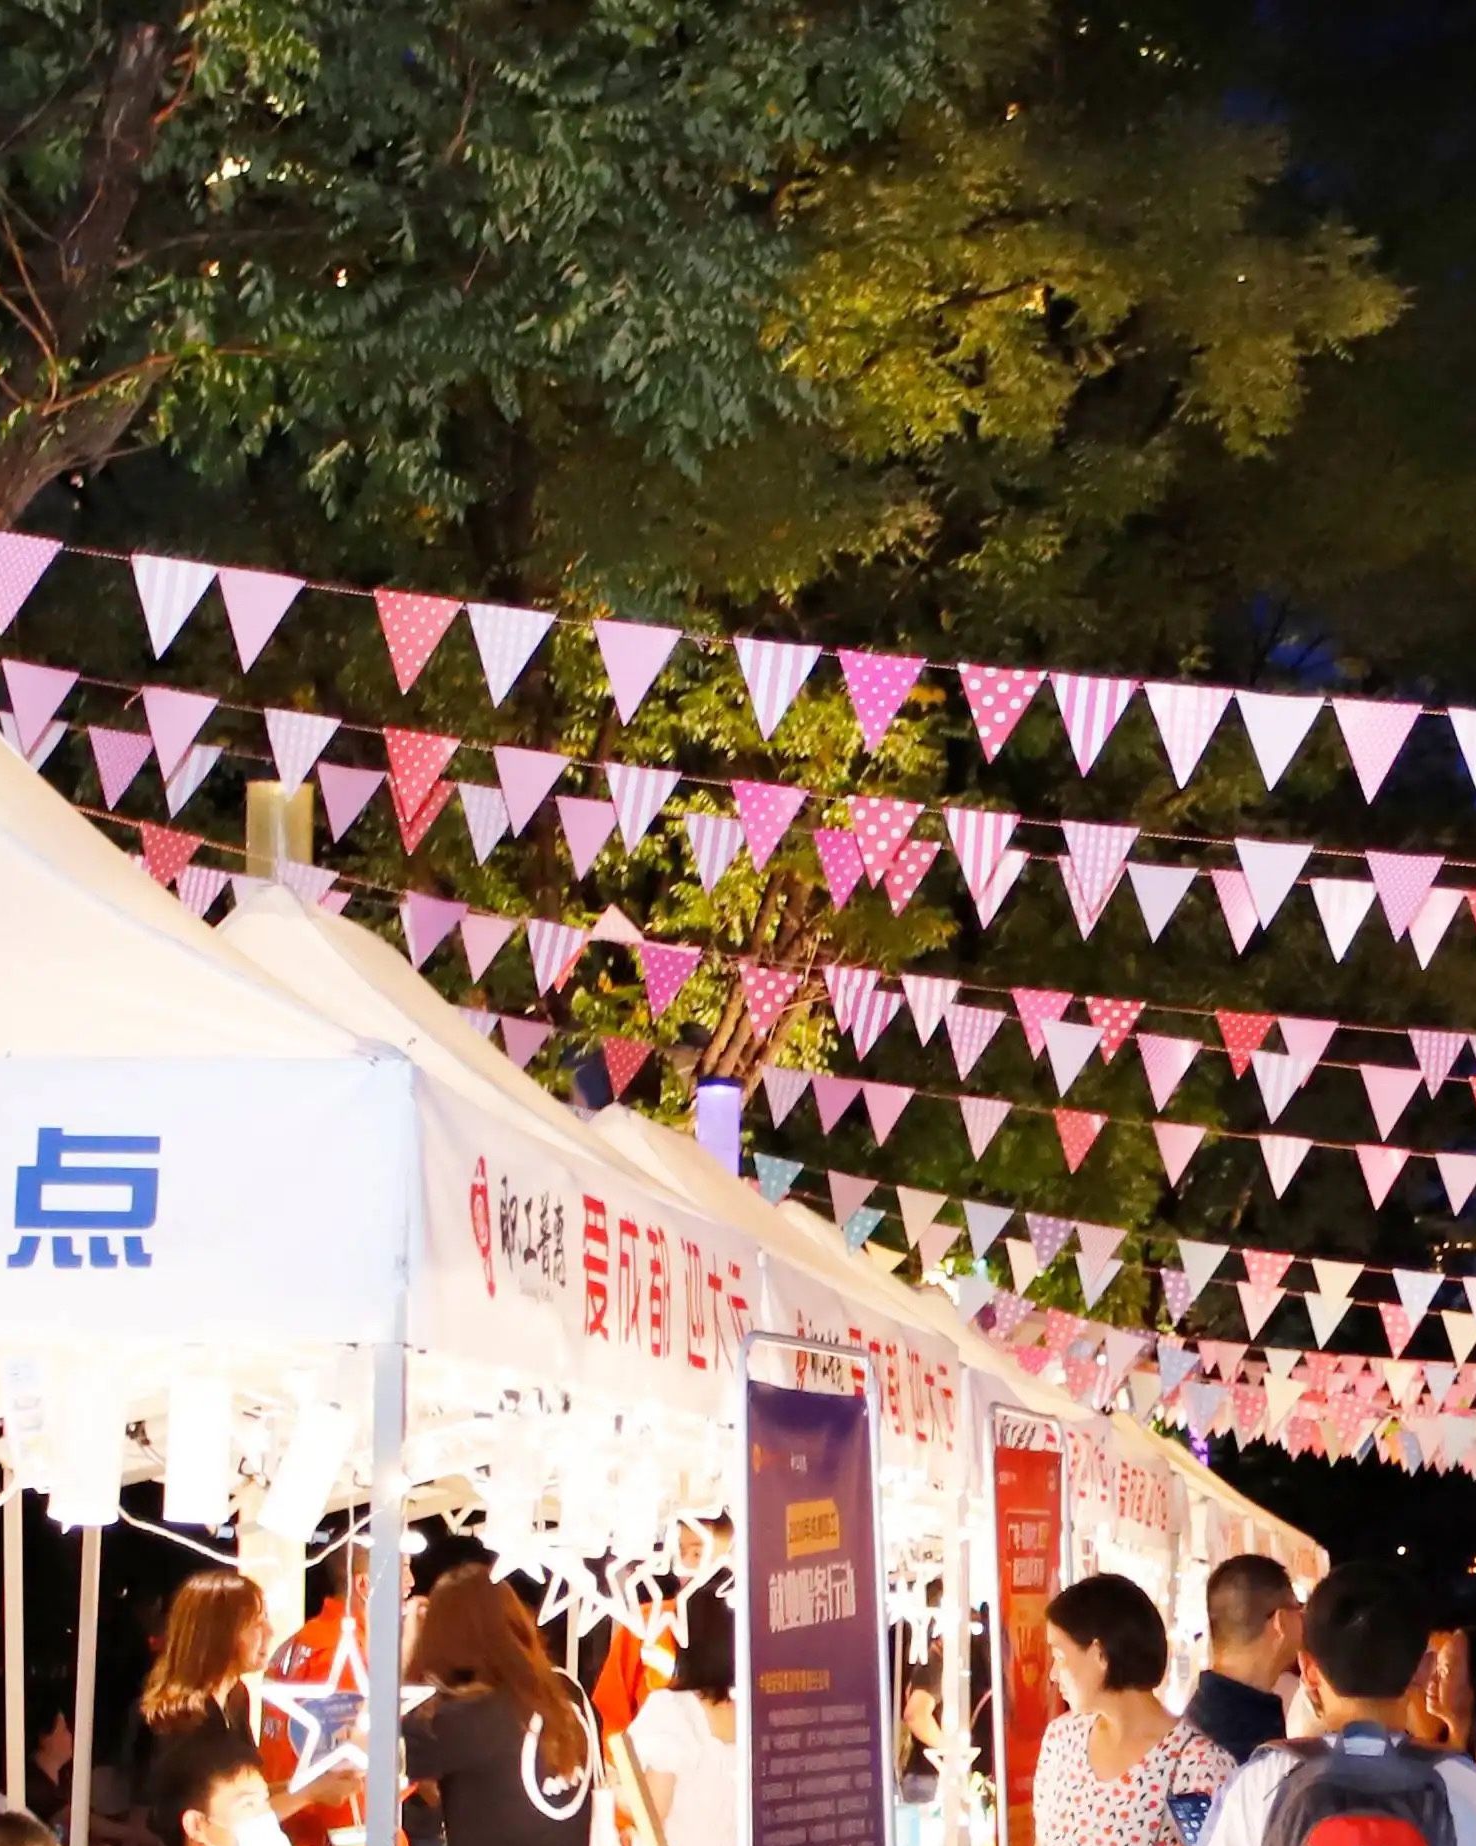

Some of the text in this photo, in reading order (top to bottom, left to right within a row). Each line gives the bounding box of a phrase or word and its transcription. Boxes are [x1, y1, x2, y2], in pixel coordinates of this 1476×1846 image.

[500, 1174, 566, 1287] 职工普惠
[582, 1193, 672, 1359] 爱成都
